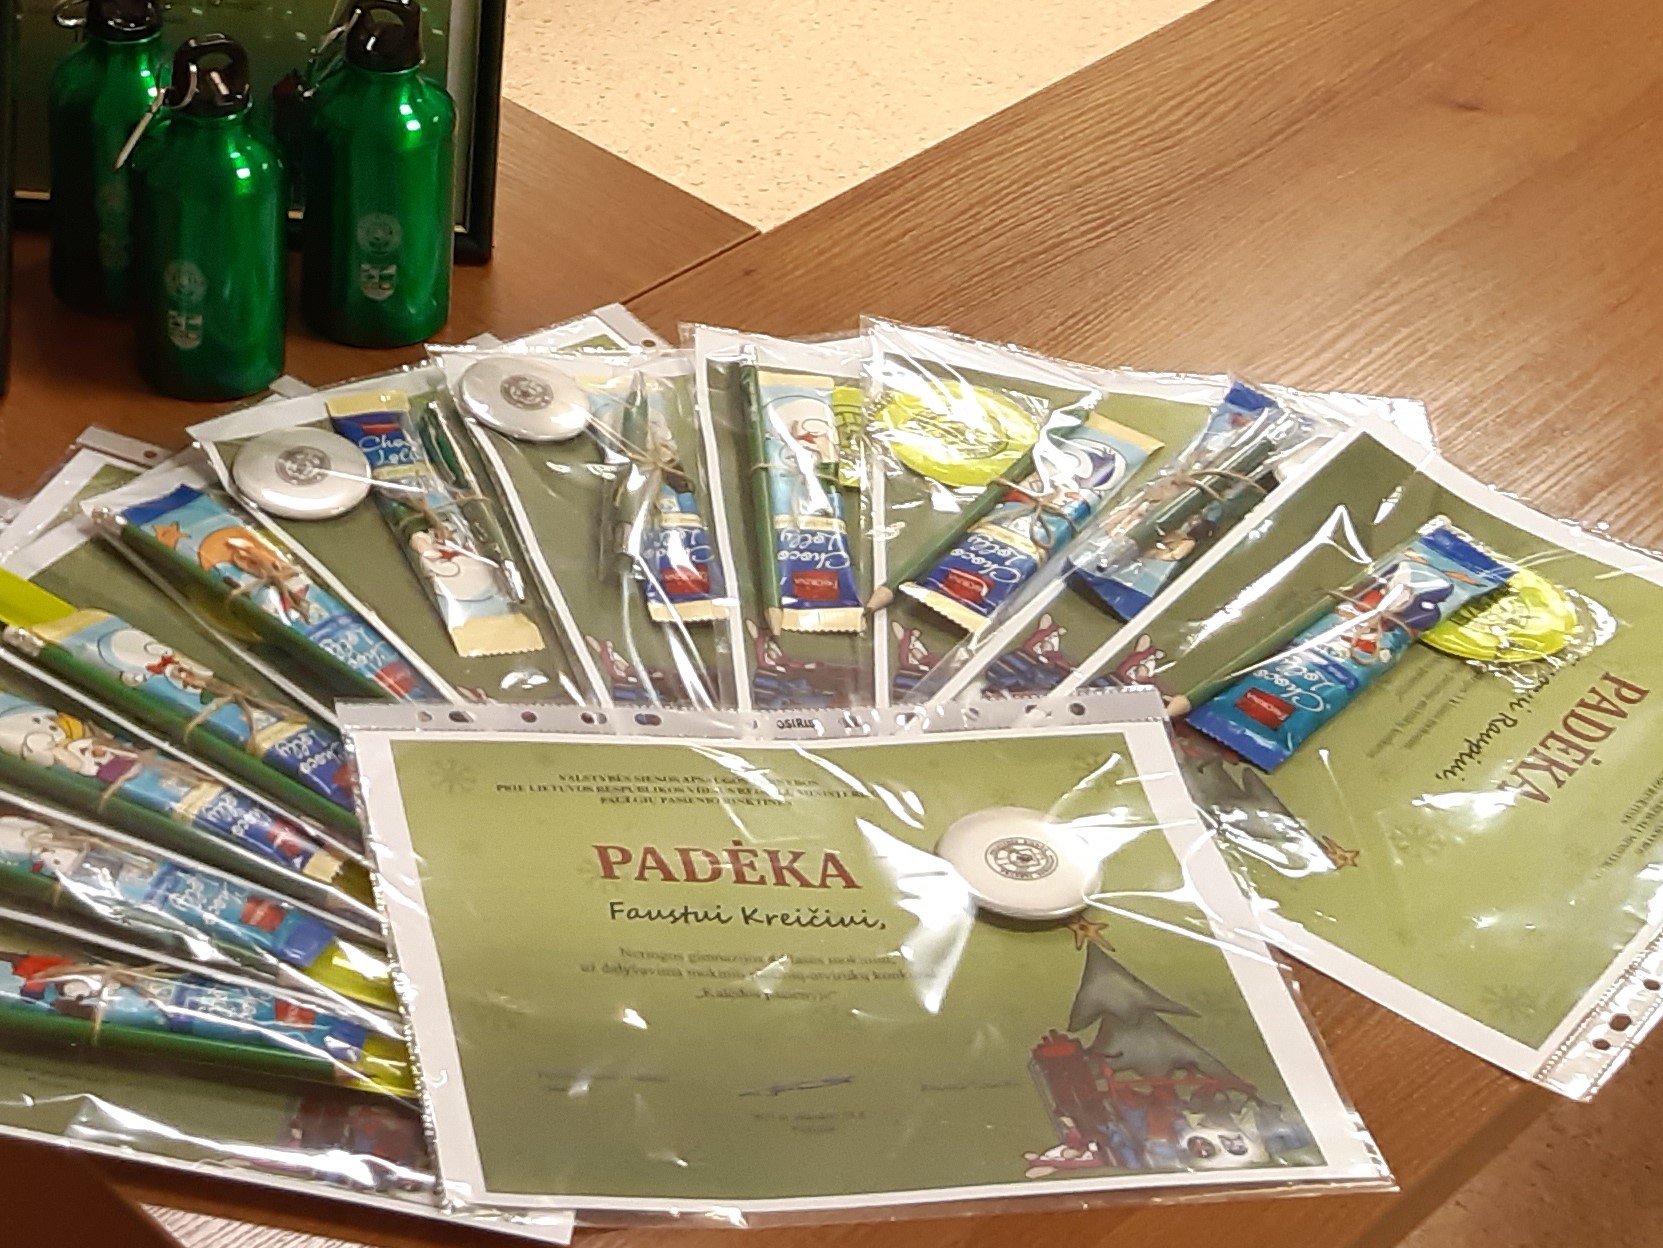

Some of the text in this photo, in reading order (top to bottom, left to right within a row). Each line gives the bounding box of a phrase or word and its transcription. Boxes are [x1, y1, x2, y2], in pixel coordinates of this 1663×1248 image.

[780, 527, 840, 550] Lolly
[967, 534, 1028, 566] Lolly
[777, 550, 851, 569] Choco
[950, 548, 1022, 583] Choco
[1253, 669, 1325, 712] Choco
[1495, 671, 1651, 804] PADĖKA
[592, 839, 863, 890] PADĖKA
[609, 901, 886, 930] Faustui Kreičiui,
